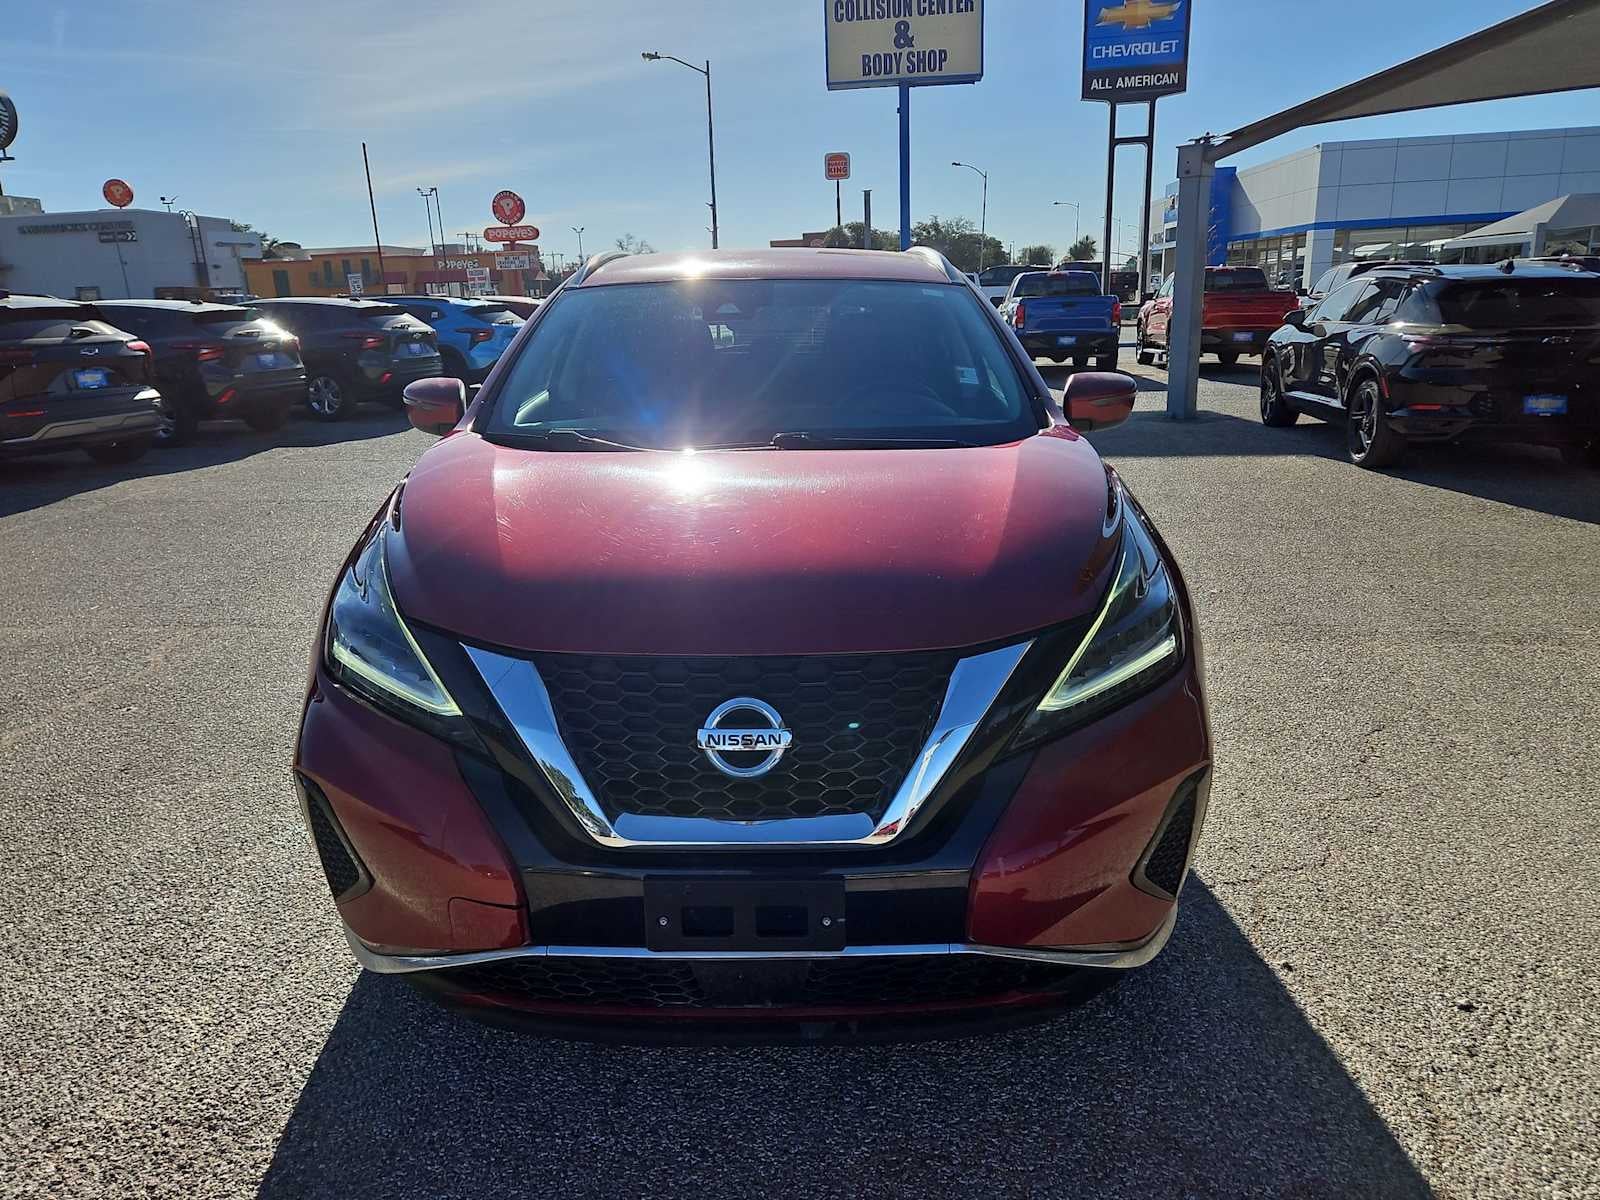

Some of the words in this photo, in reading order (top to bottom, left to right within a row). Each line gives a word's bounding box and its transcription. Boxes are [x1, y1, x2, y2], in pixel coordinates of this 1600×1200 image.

[834, 0, 913, 23] COLLISION
[893, 20, 915, 49] &
[1093, 40, 1179, 59] CHEVROLET
[862, 52, 903, 77] BODY
[906, 49, 948, 74] SHOP
[1090, 78, 1113, 90] ALL
[1115, 72, 1179, 89] AMERICAN
[827, 166, 849, 174] KING
[707, 733, 782, 747] NISSAN
